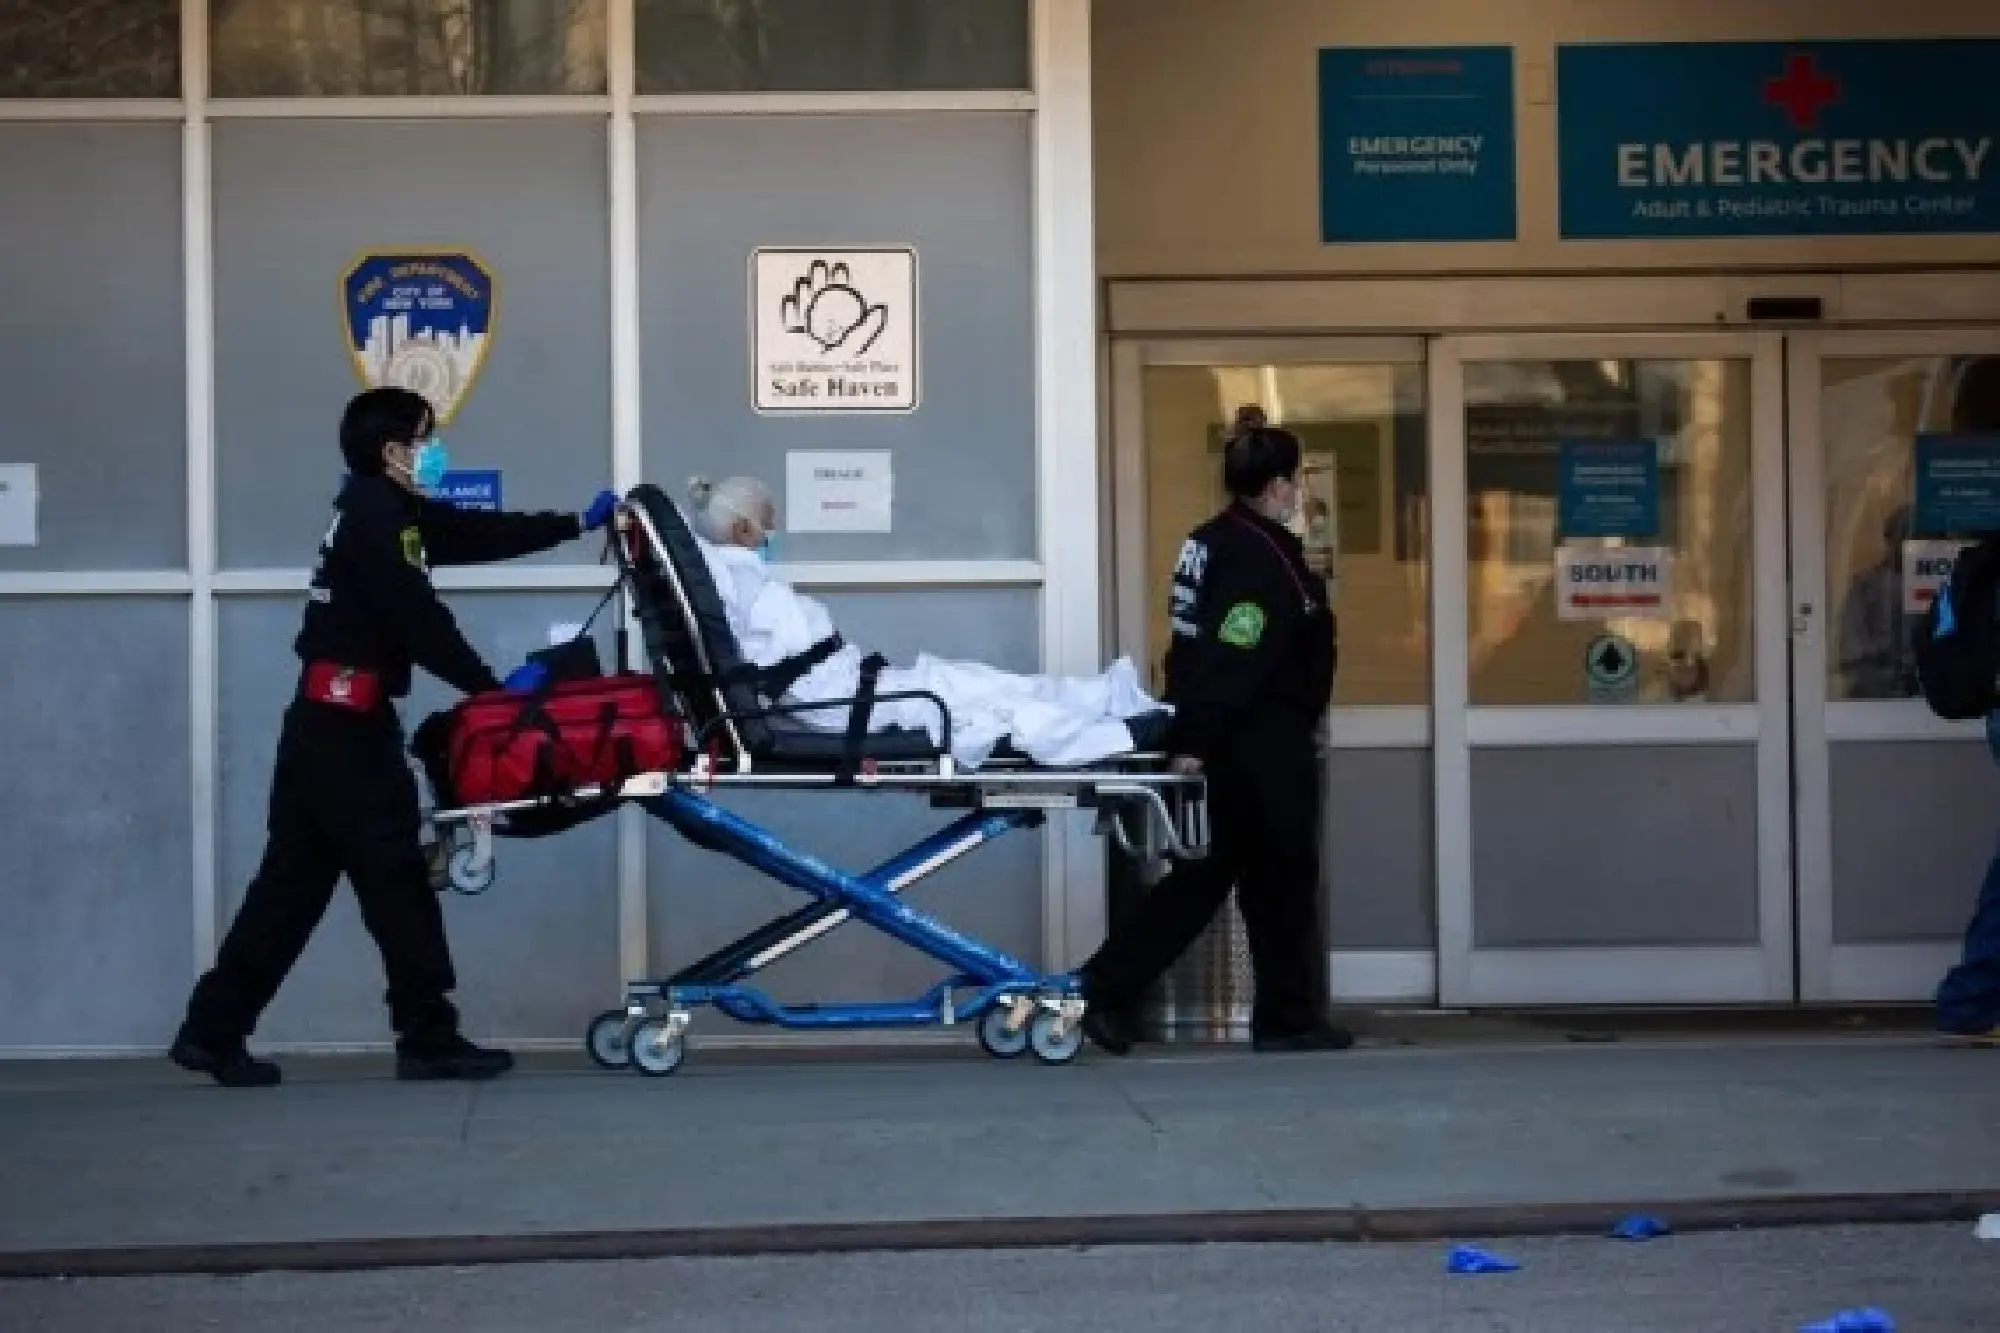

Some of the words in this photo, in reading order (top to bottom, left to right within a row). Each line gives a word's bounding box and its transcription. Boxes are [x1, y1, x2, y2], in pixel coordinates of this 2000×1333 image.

[1347, 134, 1484, 155] EMERGENCY
[1438, 158, 1477, 178] Only
[1616, 136, 1992, 187] EMERGENCY
[1632, 198, 1692, 218] Adult
[1718, 196, 1811, 216] Pediatric
[1817, 195, 1899, 215] Trauma
[1904, 194, 1976, 214] Center
[771, 378, 819, 397] Safe
[827, 378, 899, 397] Haven
[1571, 564, 1658, 584] SOUTH
